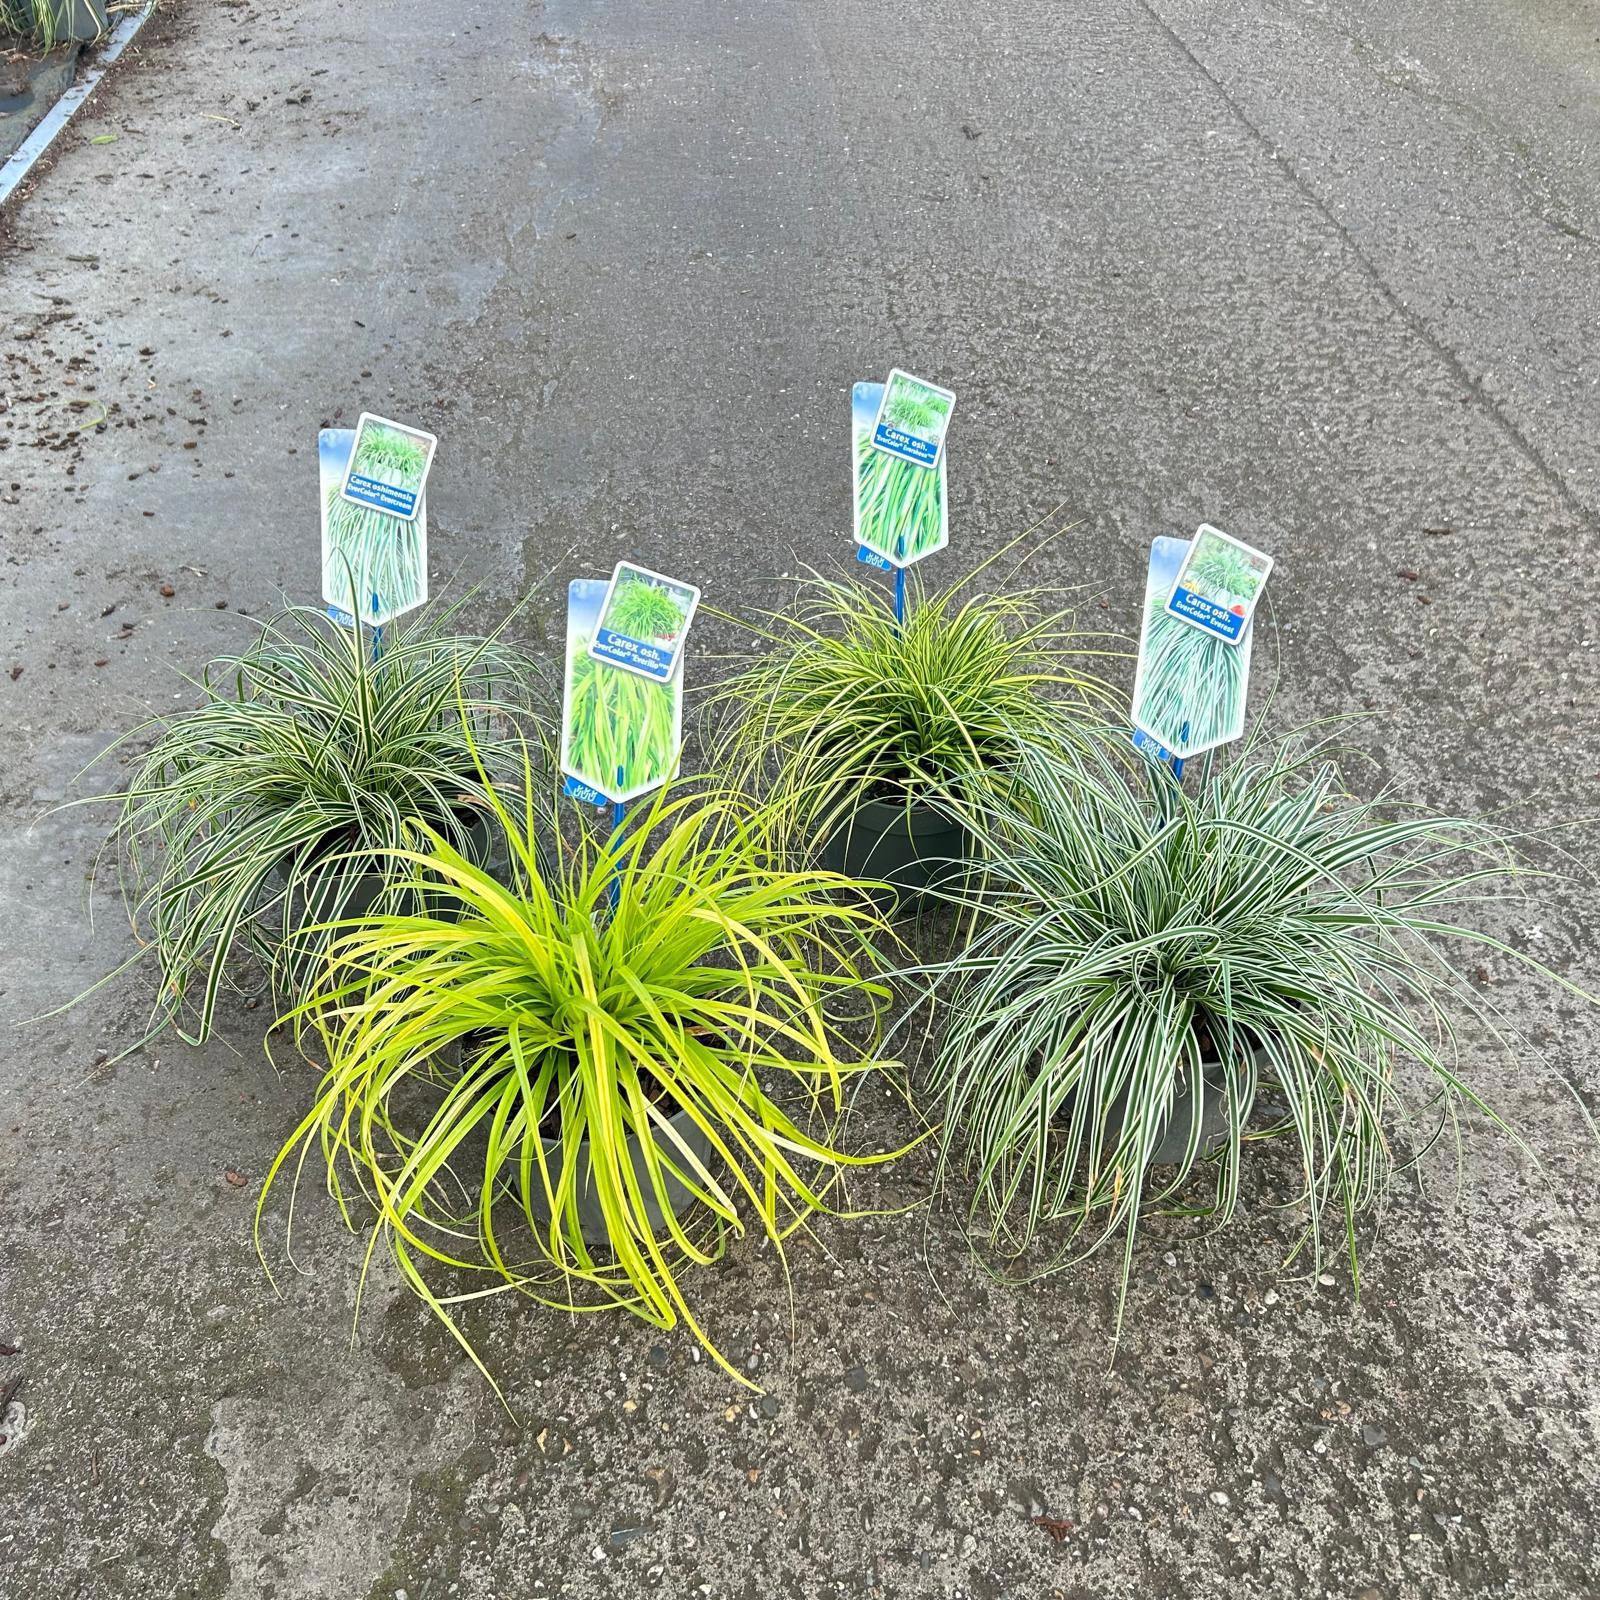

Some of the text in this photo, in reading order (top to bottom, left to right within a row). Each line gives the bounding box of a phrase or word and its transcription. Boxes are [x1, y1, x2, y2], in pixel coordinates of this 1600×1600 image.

[885, 428, 928, 452] Carex osh.
[350, 475, 413, 502] Carex oshimensis
[380, 493, 412, 510] Evercream
[1185, 594, 1231, 623] Carex osh.
[1209, 618, 1235, 634] Everest
[607, 633, 661, 661] Carex osh.
